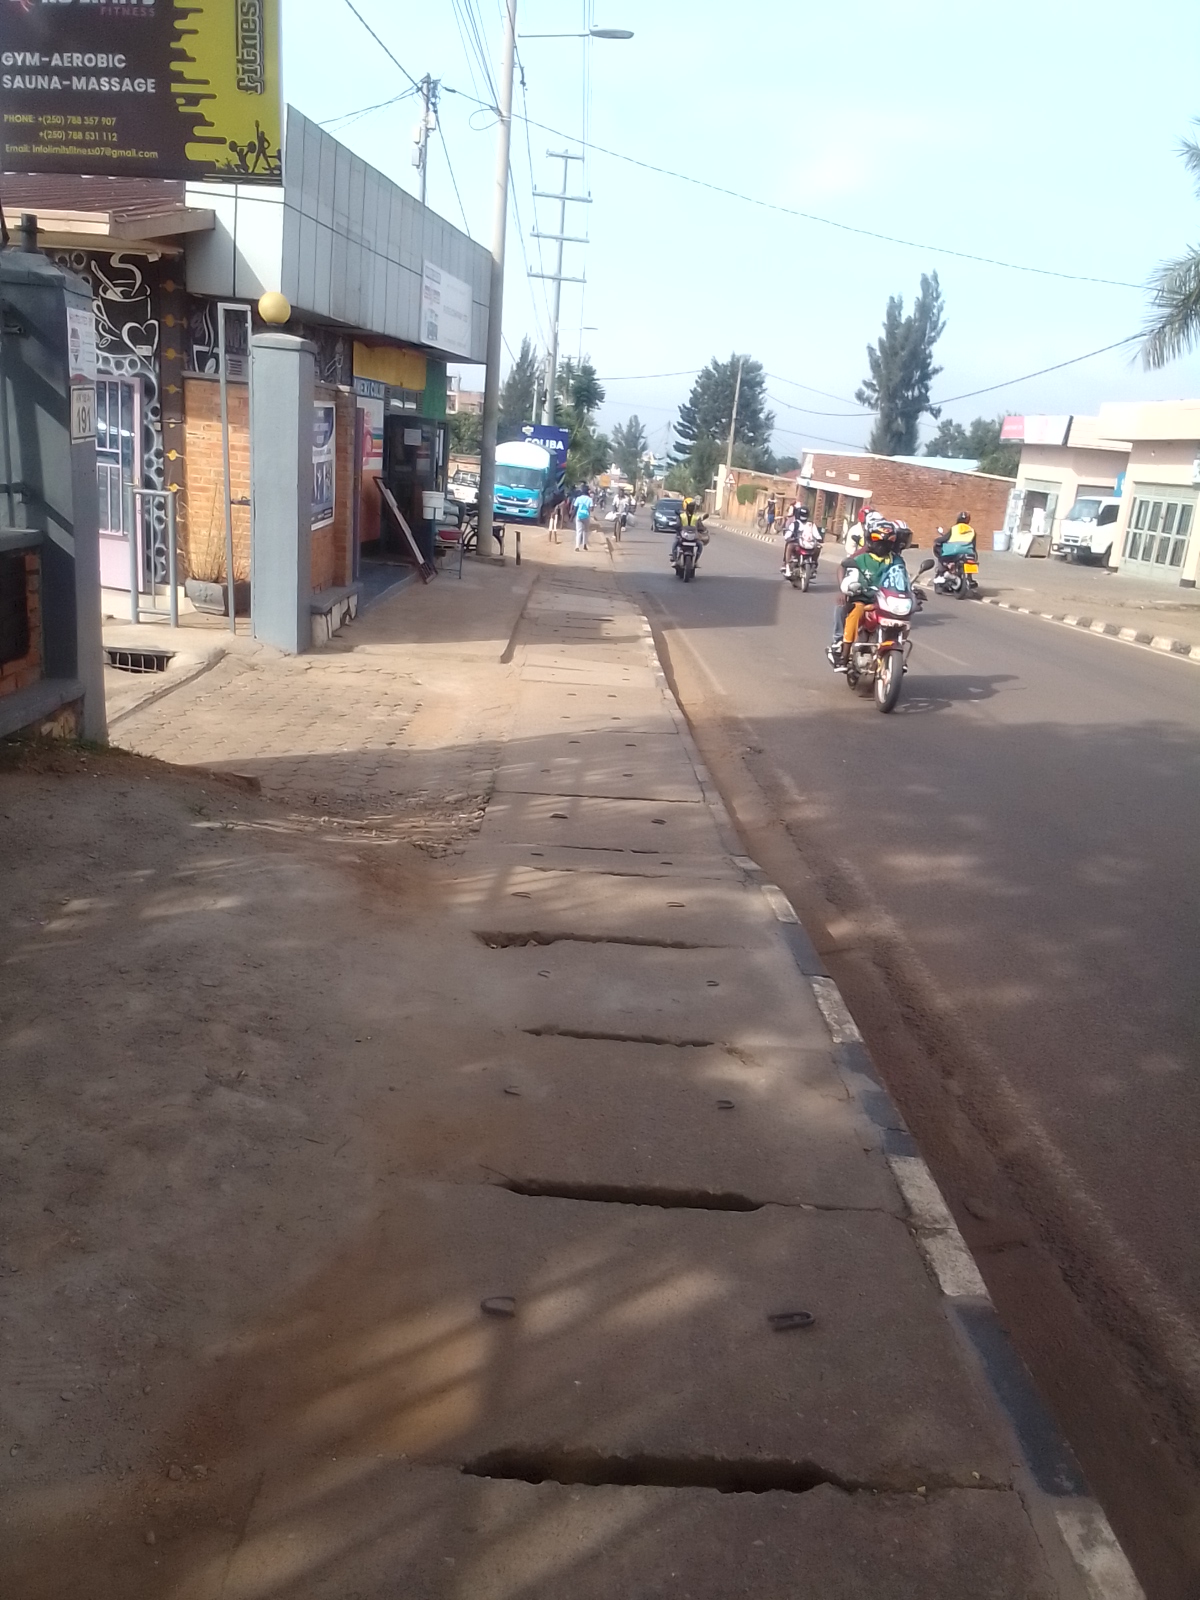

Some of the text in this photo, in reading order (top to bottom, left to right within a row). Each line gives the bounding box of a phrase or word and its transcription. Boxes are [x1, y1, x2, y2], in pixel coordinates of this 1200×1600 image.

[100, 6, 156, 17] FITNESS
[1, 51, 127, 68] GYM-AEROBIC
[2, 74, 156, 93] SAUNA-MASSAGE
[37, 115, 65, 126] +(250)
[66, 115, 82, 125] 788
[83, 116, 99, 125] 357
[101, 117, 117, 126] 907
[38, 130, 118, 142] +(250) 788 531 112
[76, 405, 92, 434] 191
